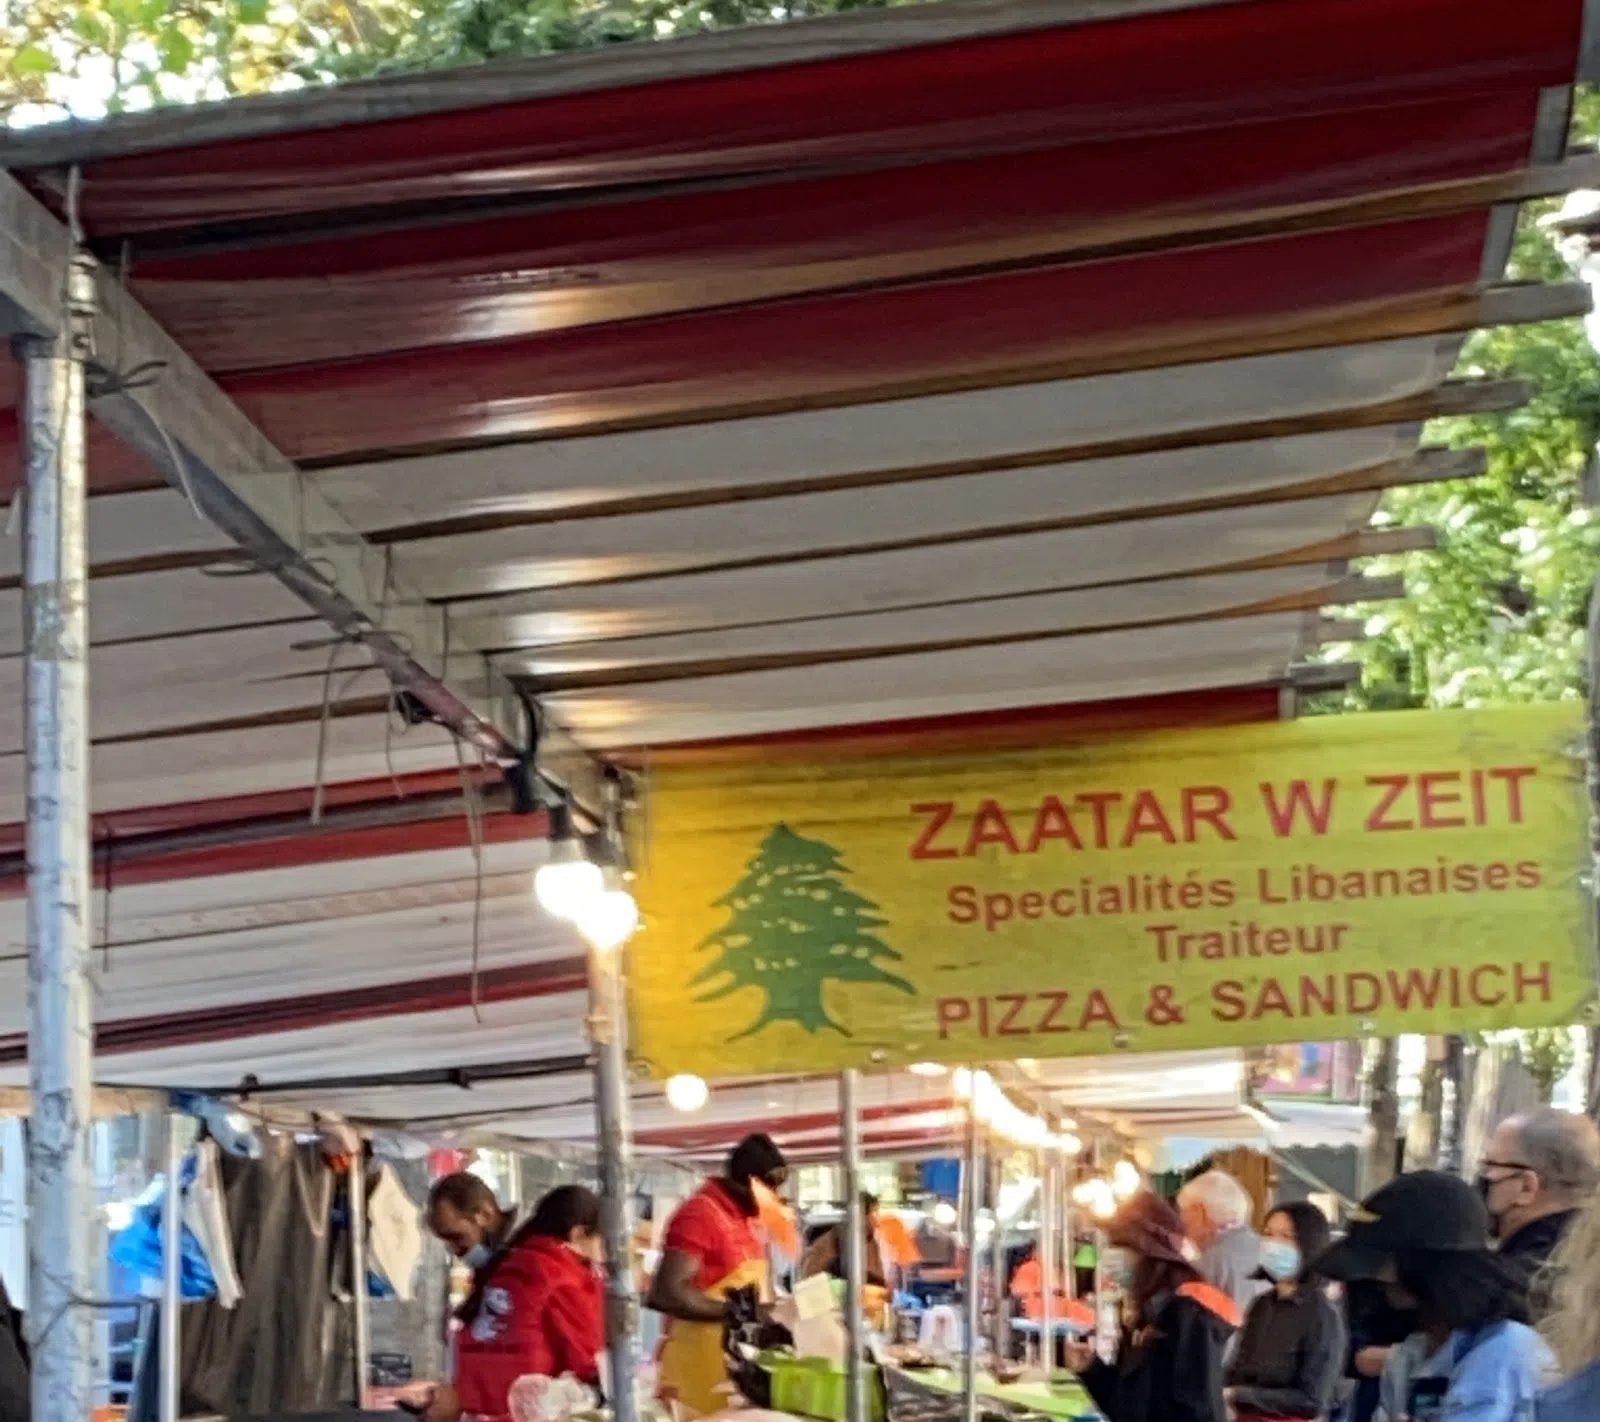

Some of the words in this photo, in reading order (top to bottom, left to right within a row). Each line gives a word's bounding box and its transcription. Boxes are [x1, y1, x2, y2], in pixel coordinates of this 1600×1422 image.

[909, 784, 1238, 860] ZAATAR
[1259, 777, 1338, 838] W
[1364, 766, 1538, 833] ZEIT
[947, 870, 1236, 932] Specialités
[1257, 856, 1543, 904] Libanaises
[1145, 920, 1348, 963] Traiteur
[936, 988, 1122, 1040] PIZZA
[1145, 984, 1185, 1026] &
[1210, 961, 1552, 1022] SANDWICH
